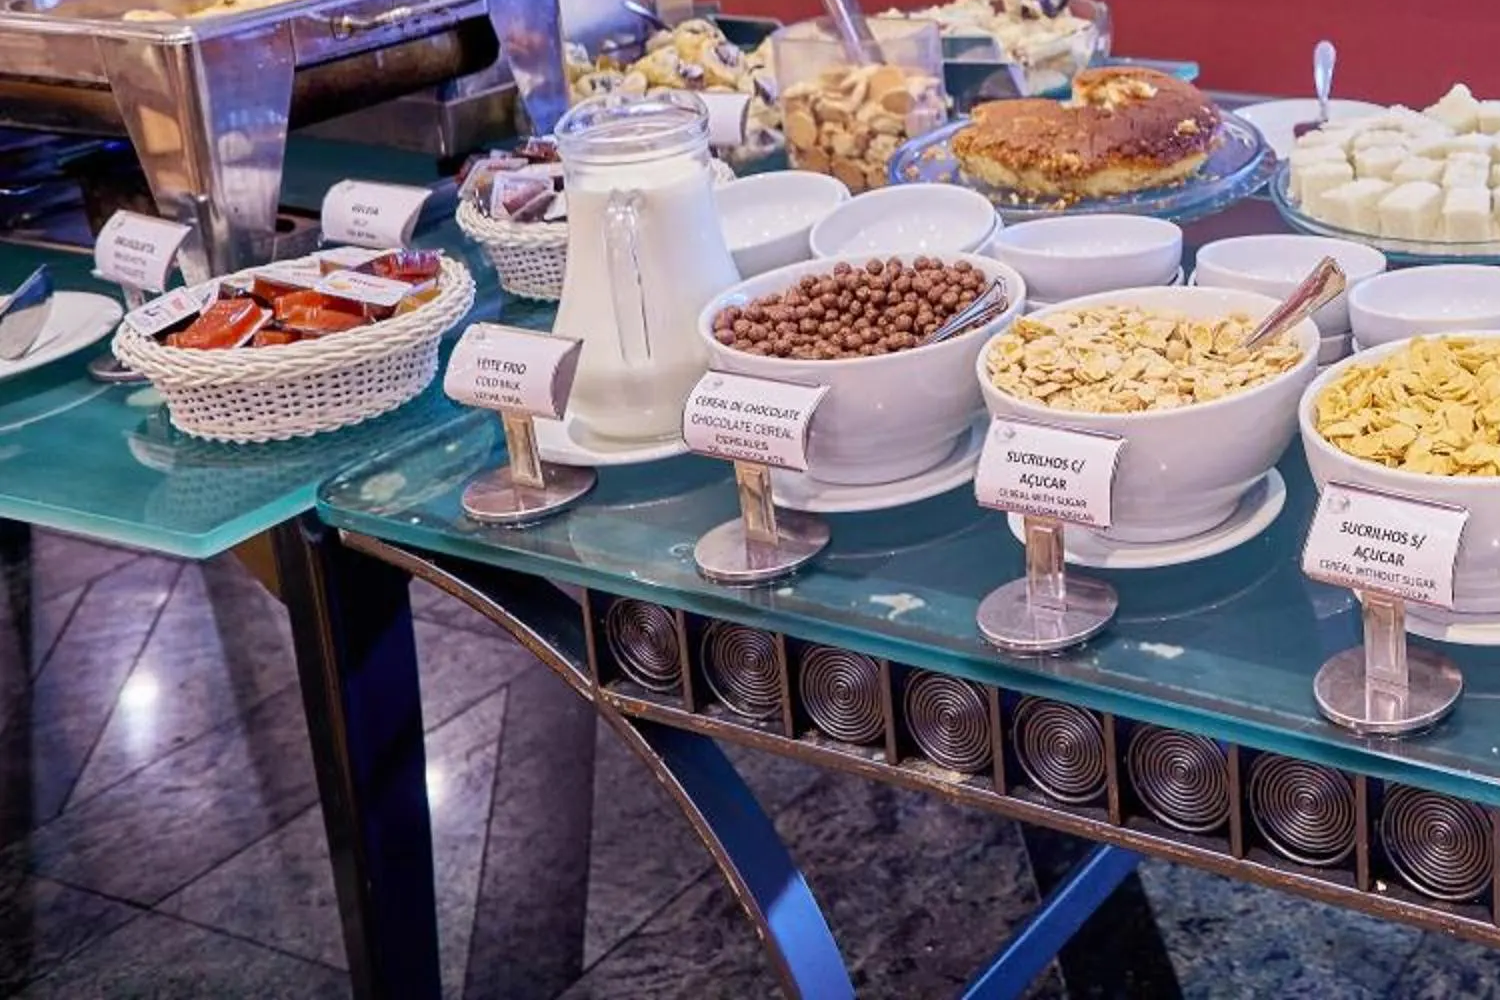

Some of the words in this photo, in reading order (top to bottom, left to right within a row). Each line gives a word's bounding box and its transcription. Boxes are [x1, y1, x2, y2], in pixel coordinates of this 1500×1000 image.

[744, 403, 801, 420] CHOCOLATE
[691, 412, 751, 433] CHOCOLATE
[753, 423, 795, 440] CEREAL
[1006, 451, 1069, 471] SUCRILHOS
[1071, 459, 1087, 474] C/
[1339, 521, 1409, 546] SUCRILHOS
[1409, 534, 1427, 550] S/
[1355, 566, 1401, 583] WITHOUT
